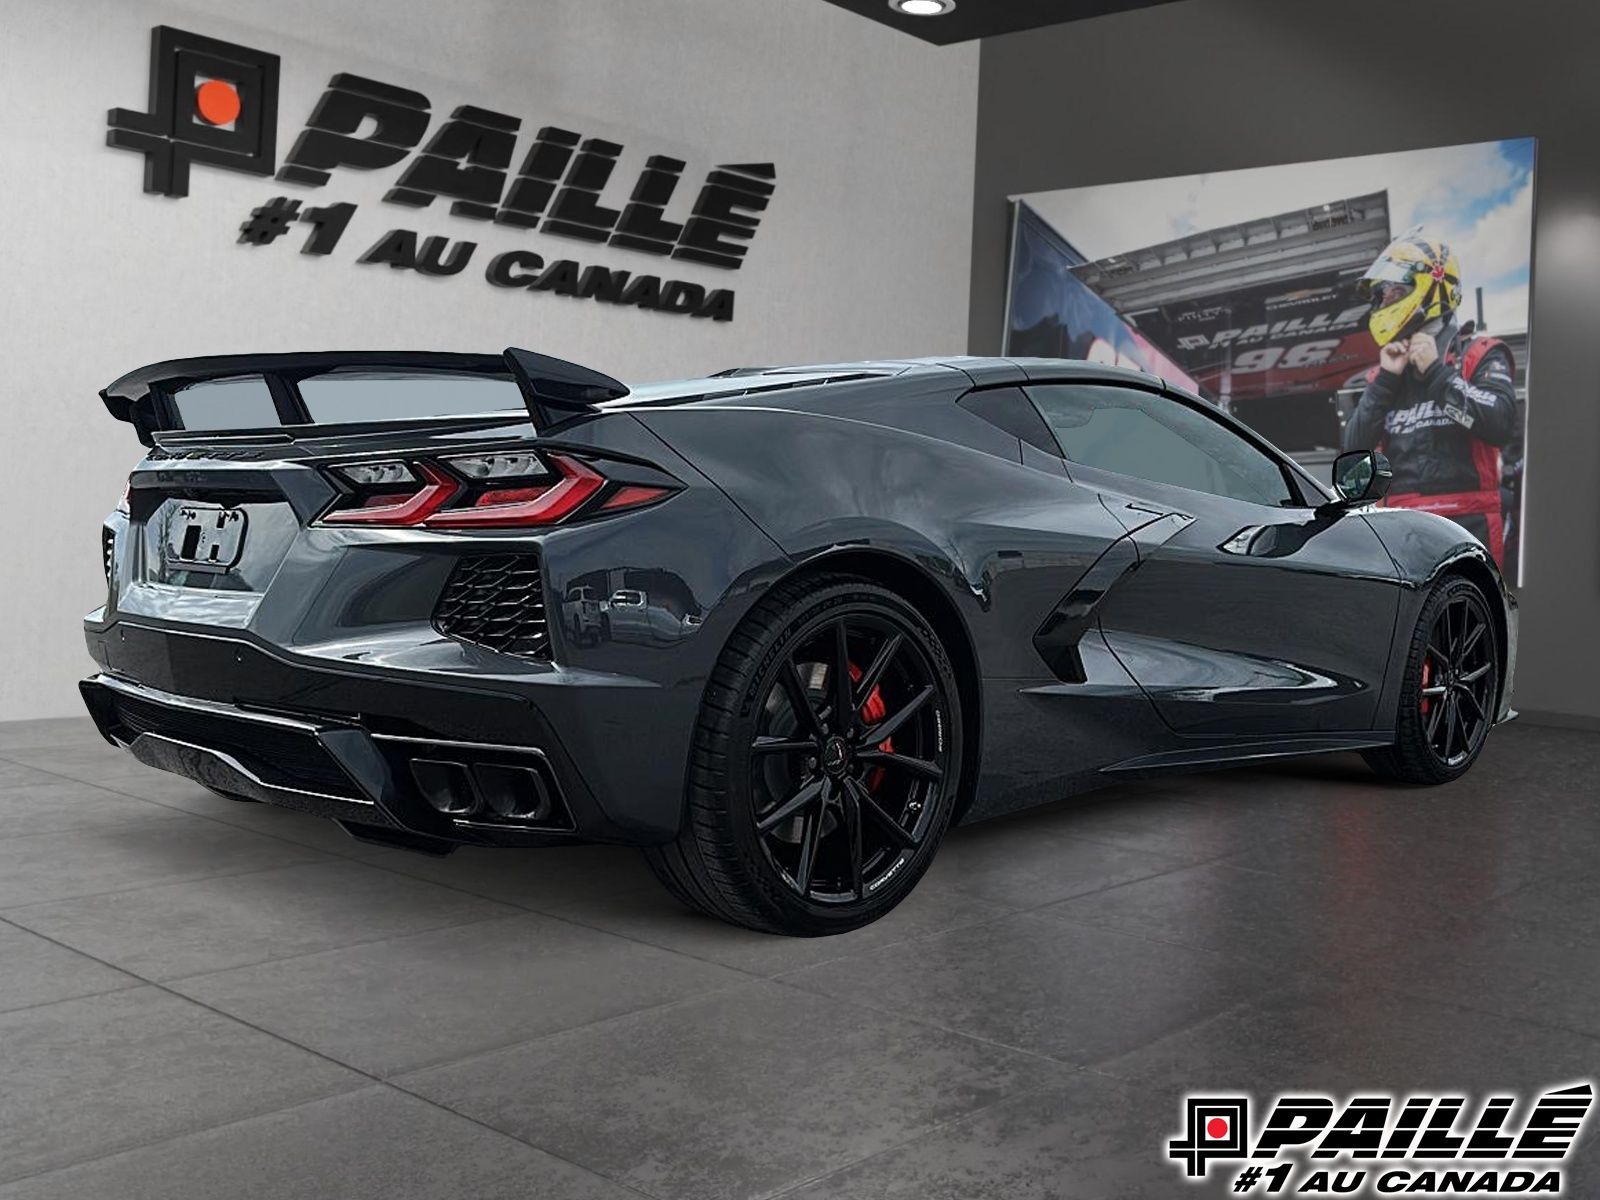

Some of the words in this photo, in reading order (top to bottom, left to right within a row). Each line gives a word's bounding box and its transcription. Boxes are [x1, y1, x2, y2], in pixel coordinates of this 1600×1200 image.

[275, 72, 776, 270] PAILLÉ
[236, 196, 358, 256] #1
[356, 229, 477, 276] AU
[485, 250, 735, 322] CANADA
[1230, 339, 1341, 374] 96
